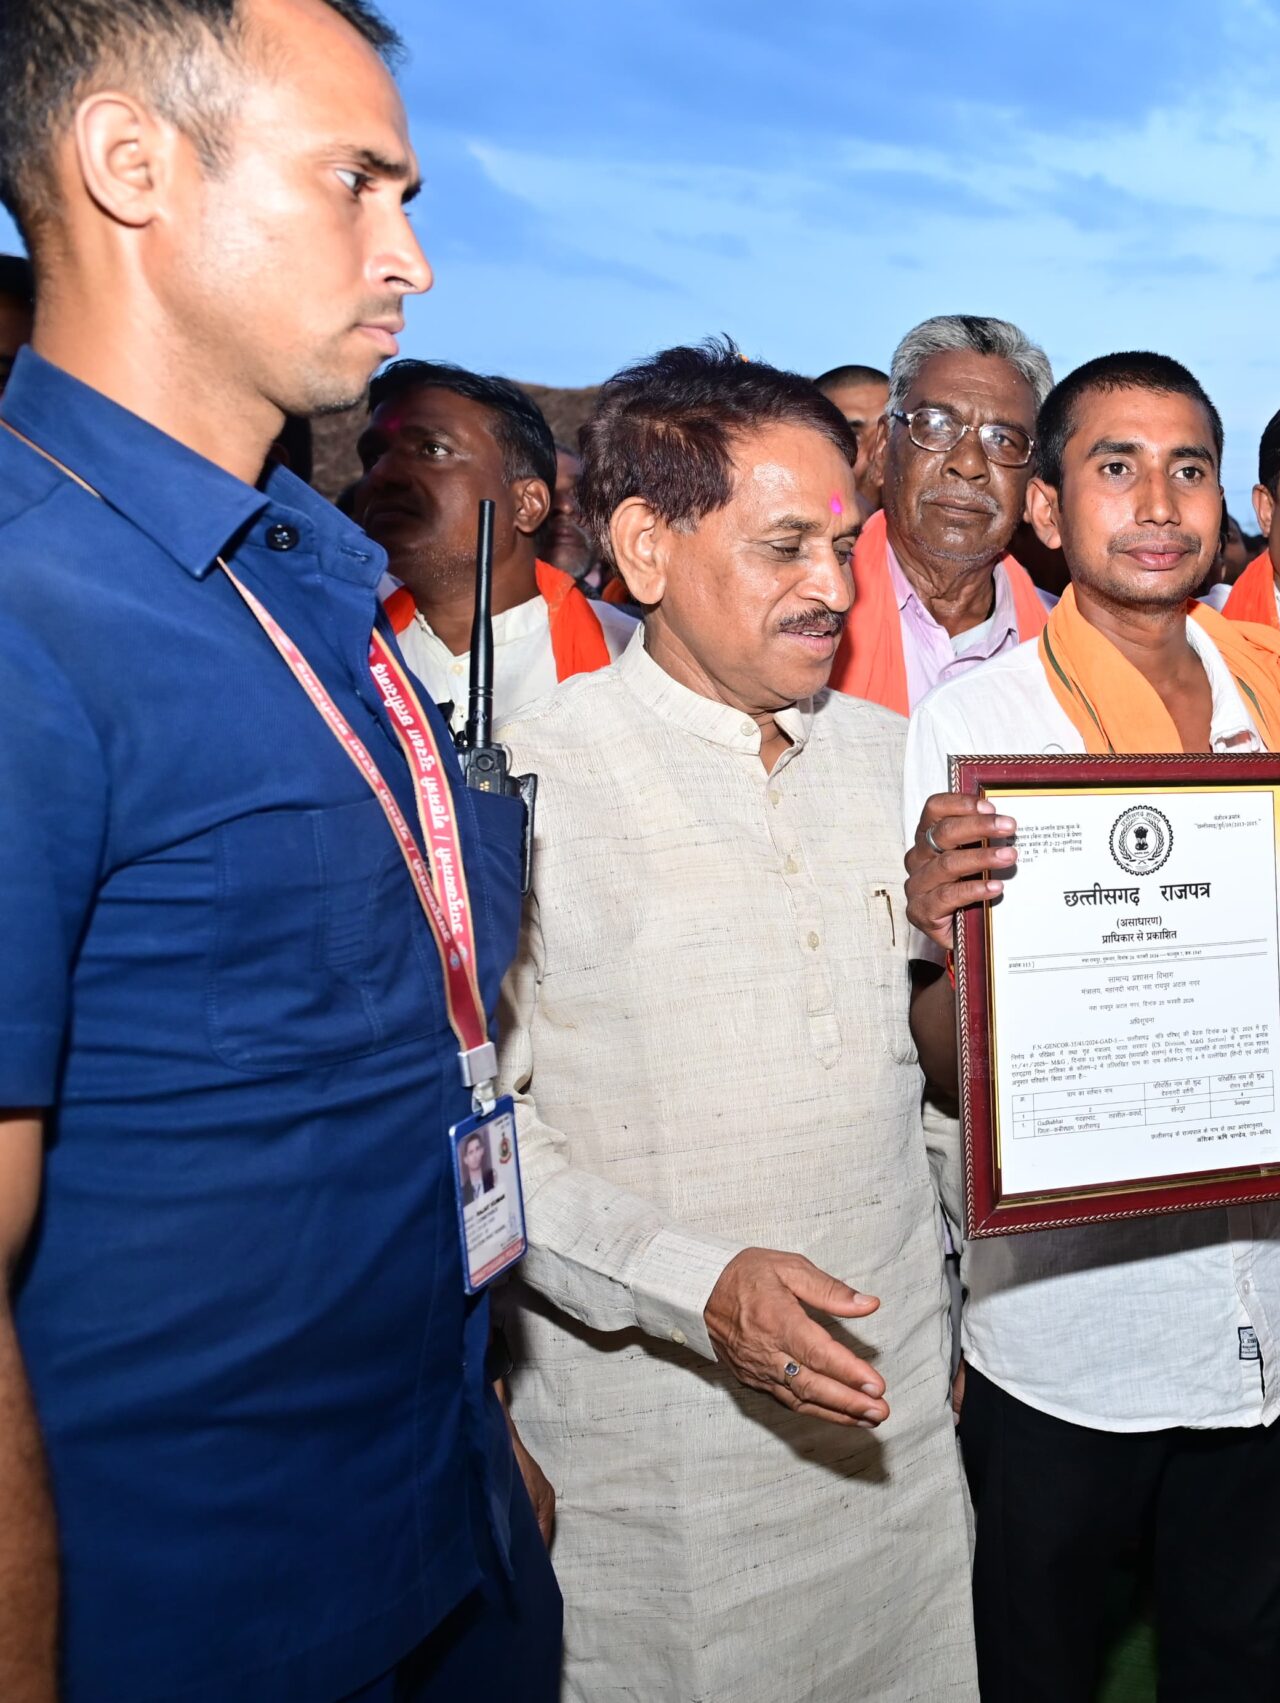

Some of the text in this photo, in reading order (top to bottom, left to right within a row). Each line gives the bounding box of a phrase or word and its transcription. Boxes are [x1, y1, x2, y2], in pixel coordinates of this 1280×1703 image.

[369, 662, 414, 729] छत्तीसगढ़
[407, 726, 437, 773] सुरक्षा
[420, 776, 445, 830] गृहमंत्री
[434, 844, 464, 935] उपमुख्यमंत्री
[1063, 882, 1211, 907] छत्तीसगढ़ राजपत्र
[1102, 927, 1177, 944] प्राधिकार से प्रकाशित
[1116, 915, 1162, 929] (असाधारण)
